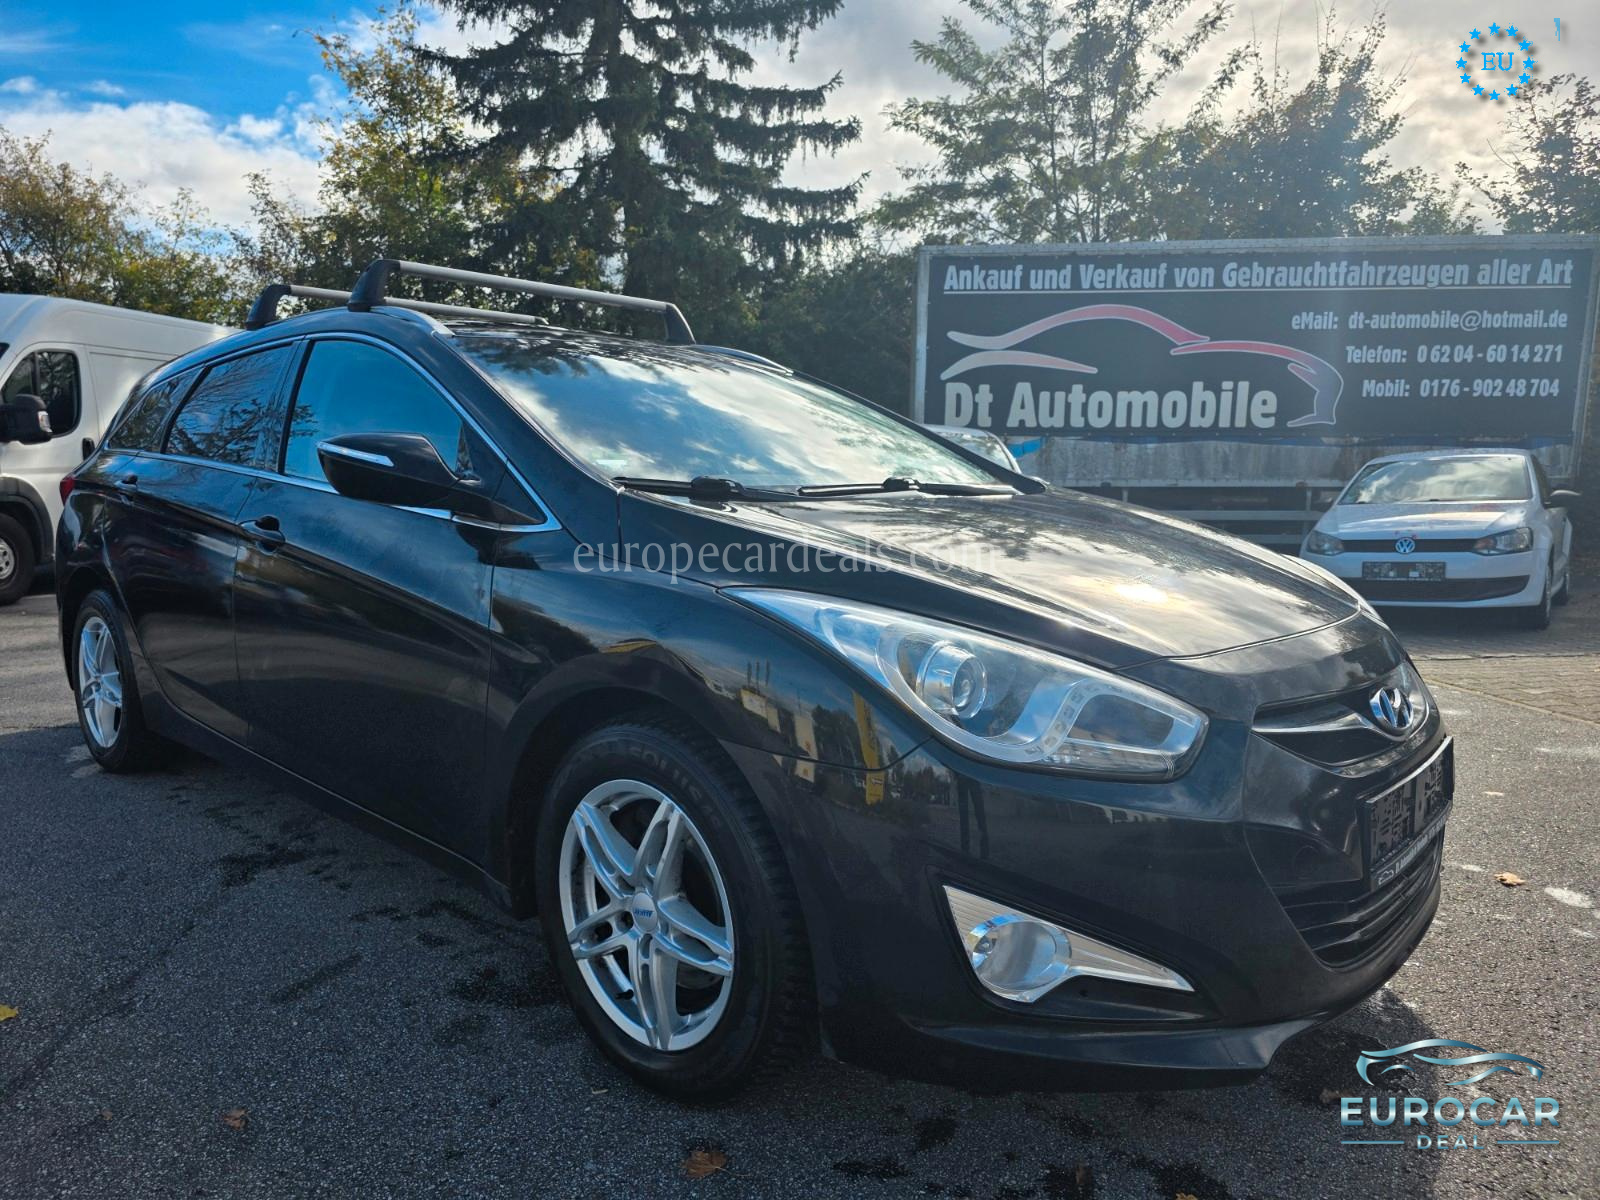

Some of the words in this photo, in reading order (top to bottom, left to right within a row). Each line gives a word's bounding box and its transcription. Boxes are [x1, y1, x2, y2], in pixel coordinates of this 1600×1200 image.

[943, 265, 1023, 290] Ankauf
[1030, 264, 1072, 290] und
[1079, 262, 1167, 289] Verkauf
[1174, 266, 1214, 288] von
[1222, 260, 1470, 289] Gebrauchtfahrzeugen
[1477, 259, 1531, 285] aller
[1537, 259, 1573, 285] Art
[1291, 312, 1339, 330] eMail:
[1348, 310, 1568, 332] dt-automobile@hotmail.de
[1346, 346, 1407, 363] Telefon:
[1362, 378, 1410, 397] Mobil:
[1420, 379, 1461, 397] 0176
[944, 382, 994, 427] Dt
[1006, 381, 1277, 428] Automobile
